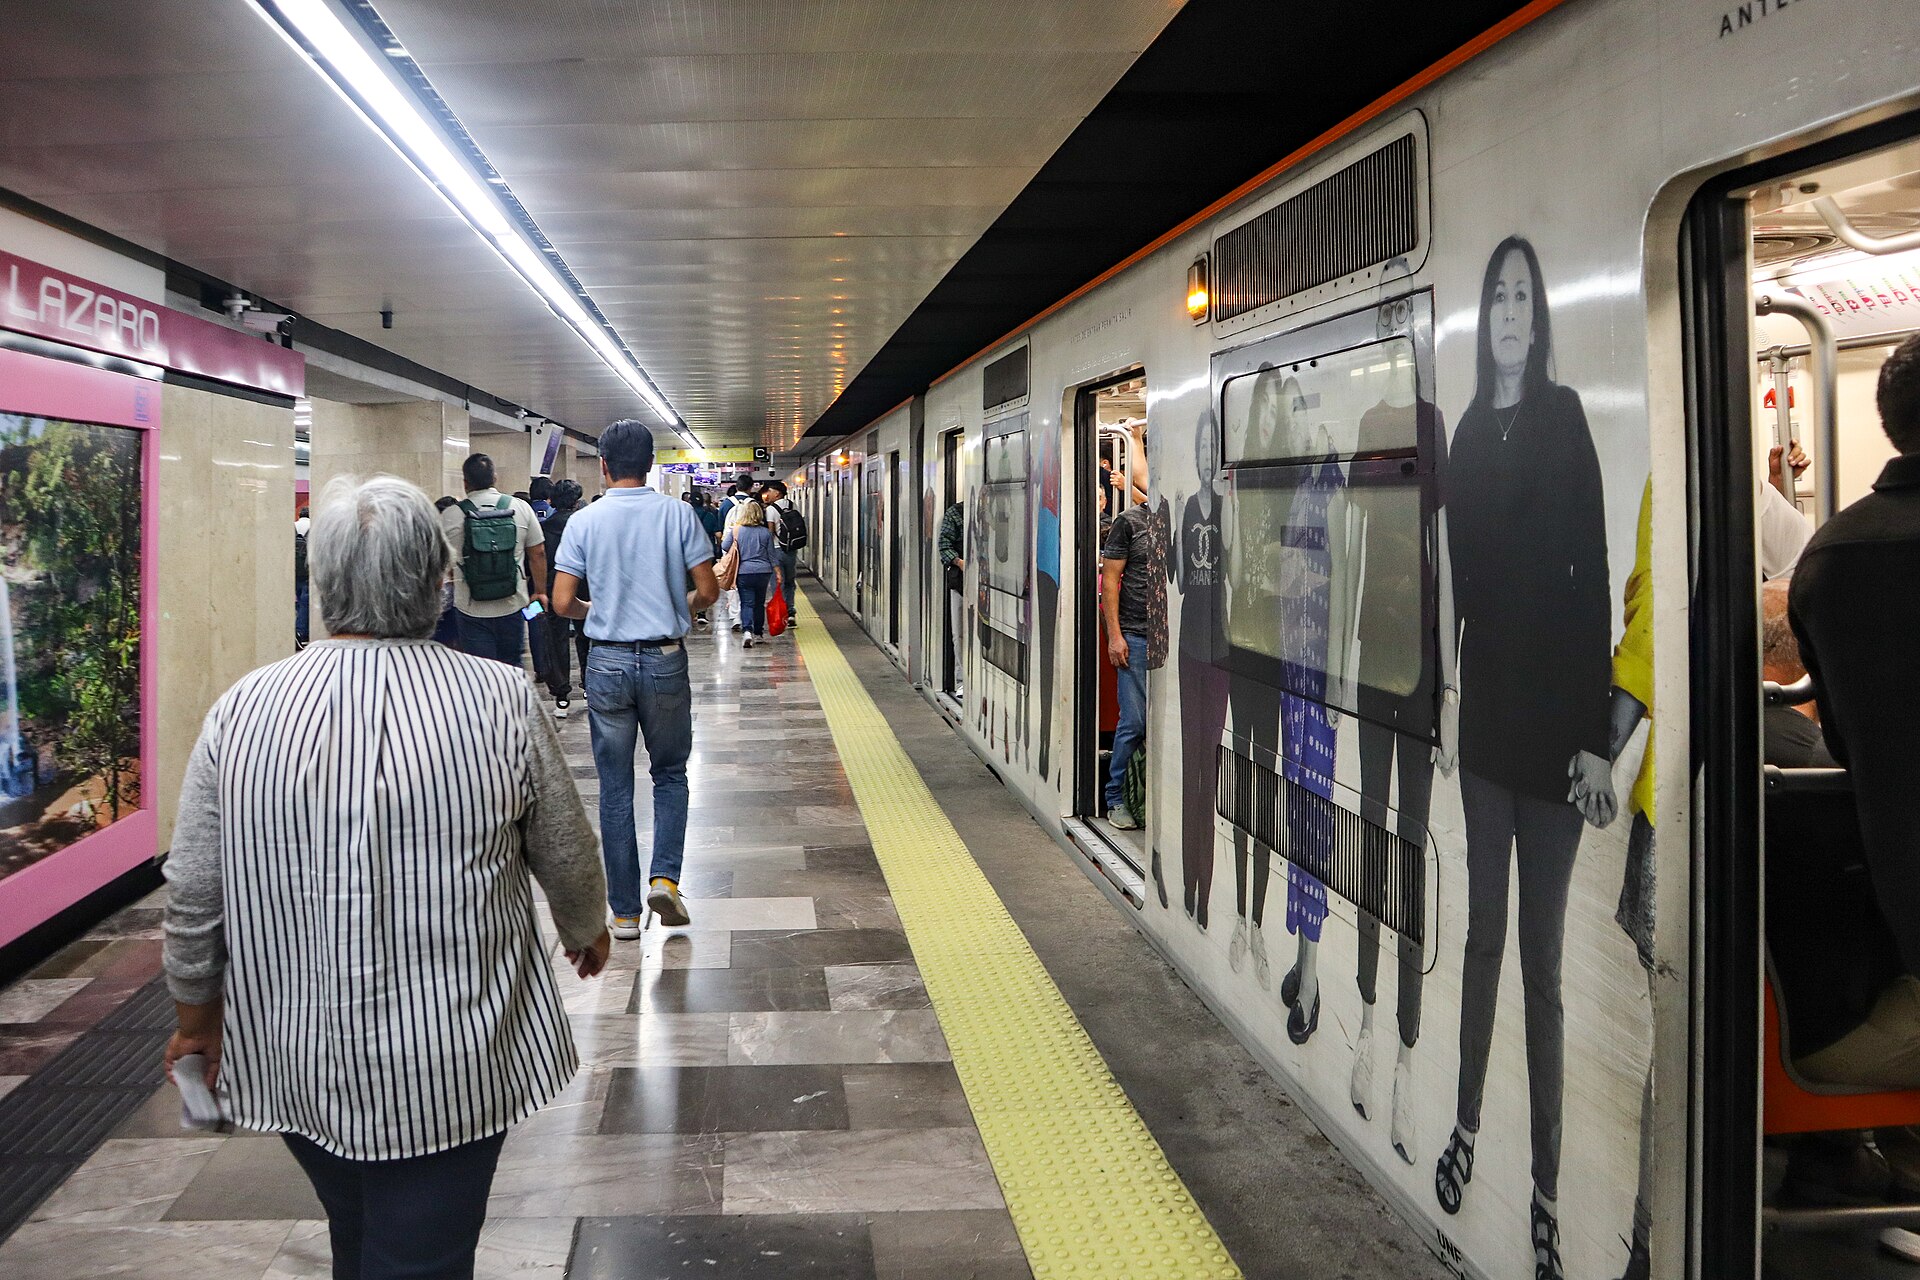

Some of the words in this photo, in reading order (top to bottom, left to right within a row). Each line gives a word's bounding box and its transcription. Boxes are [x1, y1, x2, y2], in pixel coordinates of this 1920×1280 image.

[1719, 0, 1803, 39] ANT
[8, 265, 161, 352] LAZARO
[756, 449, 765, 458] C
